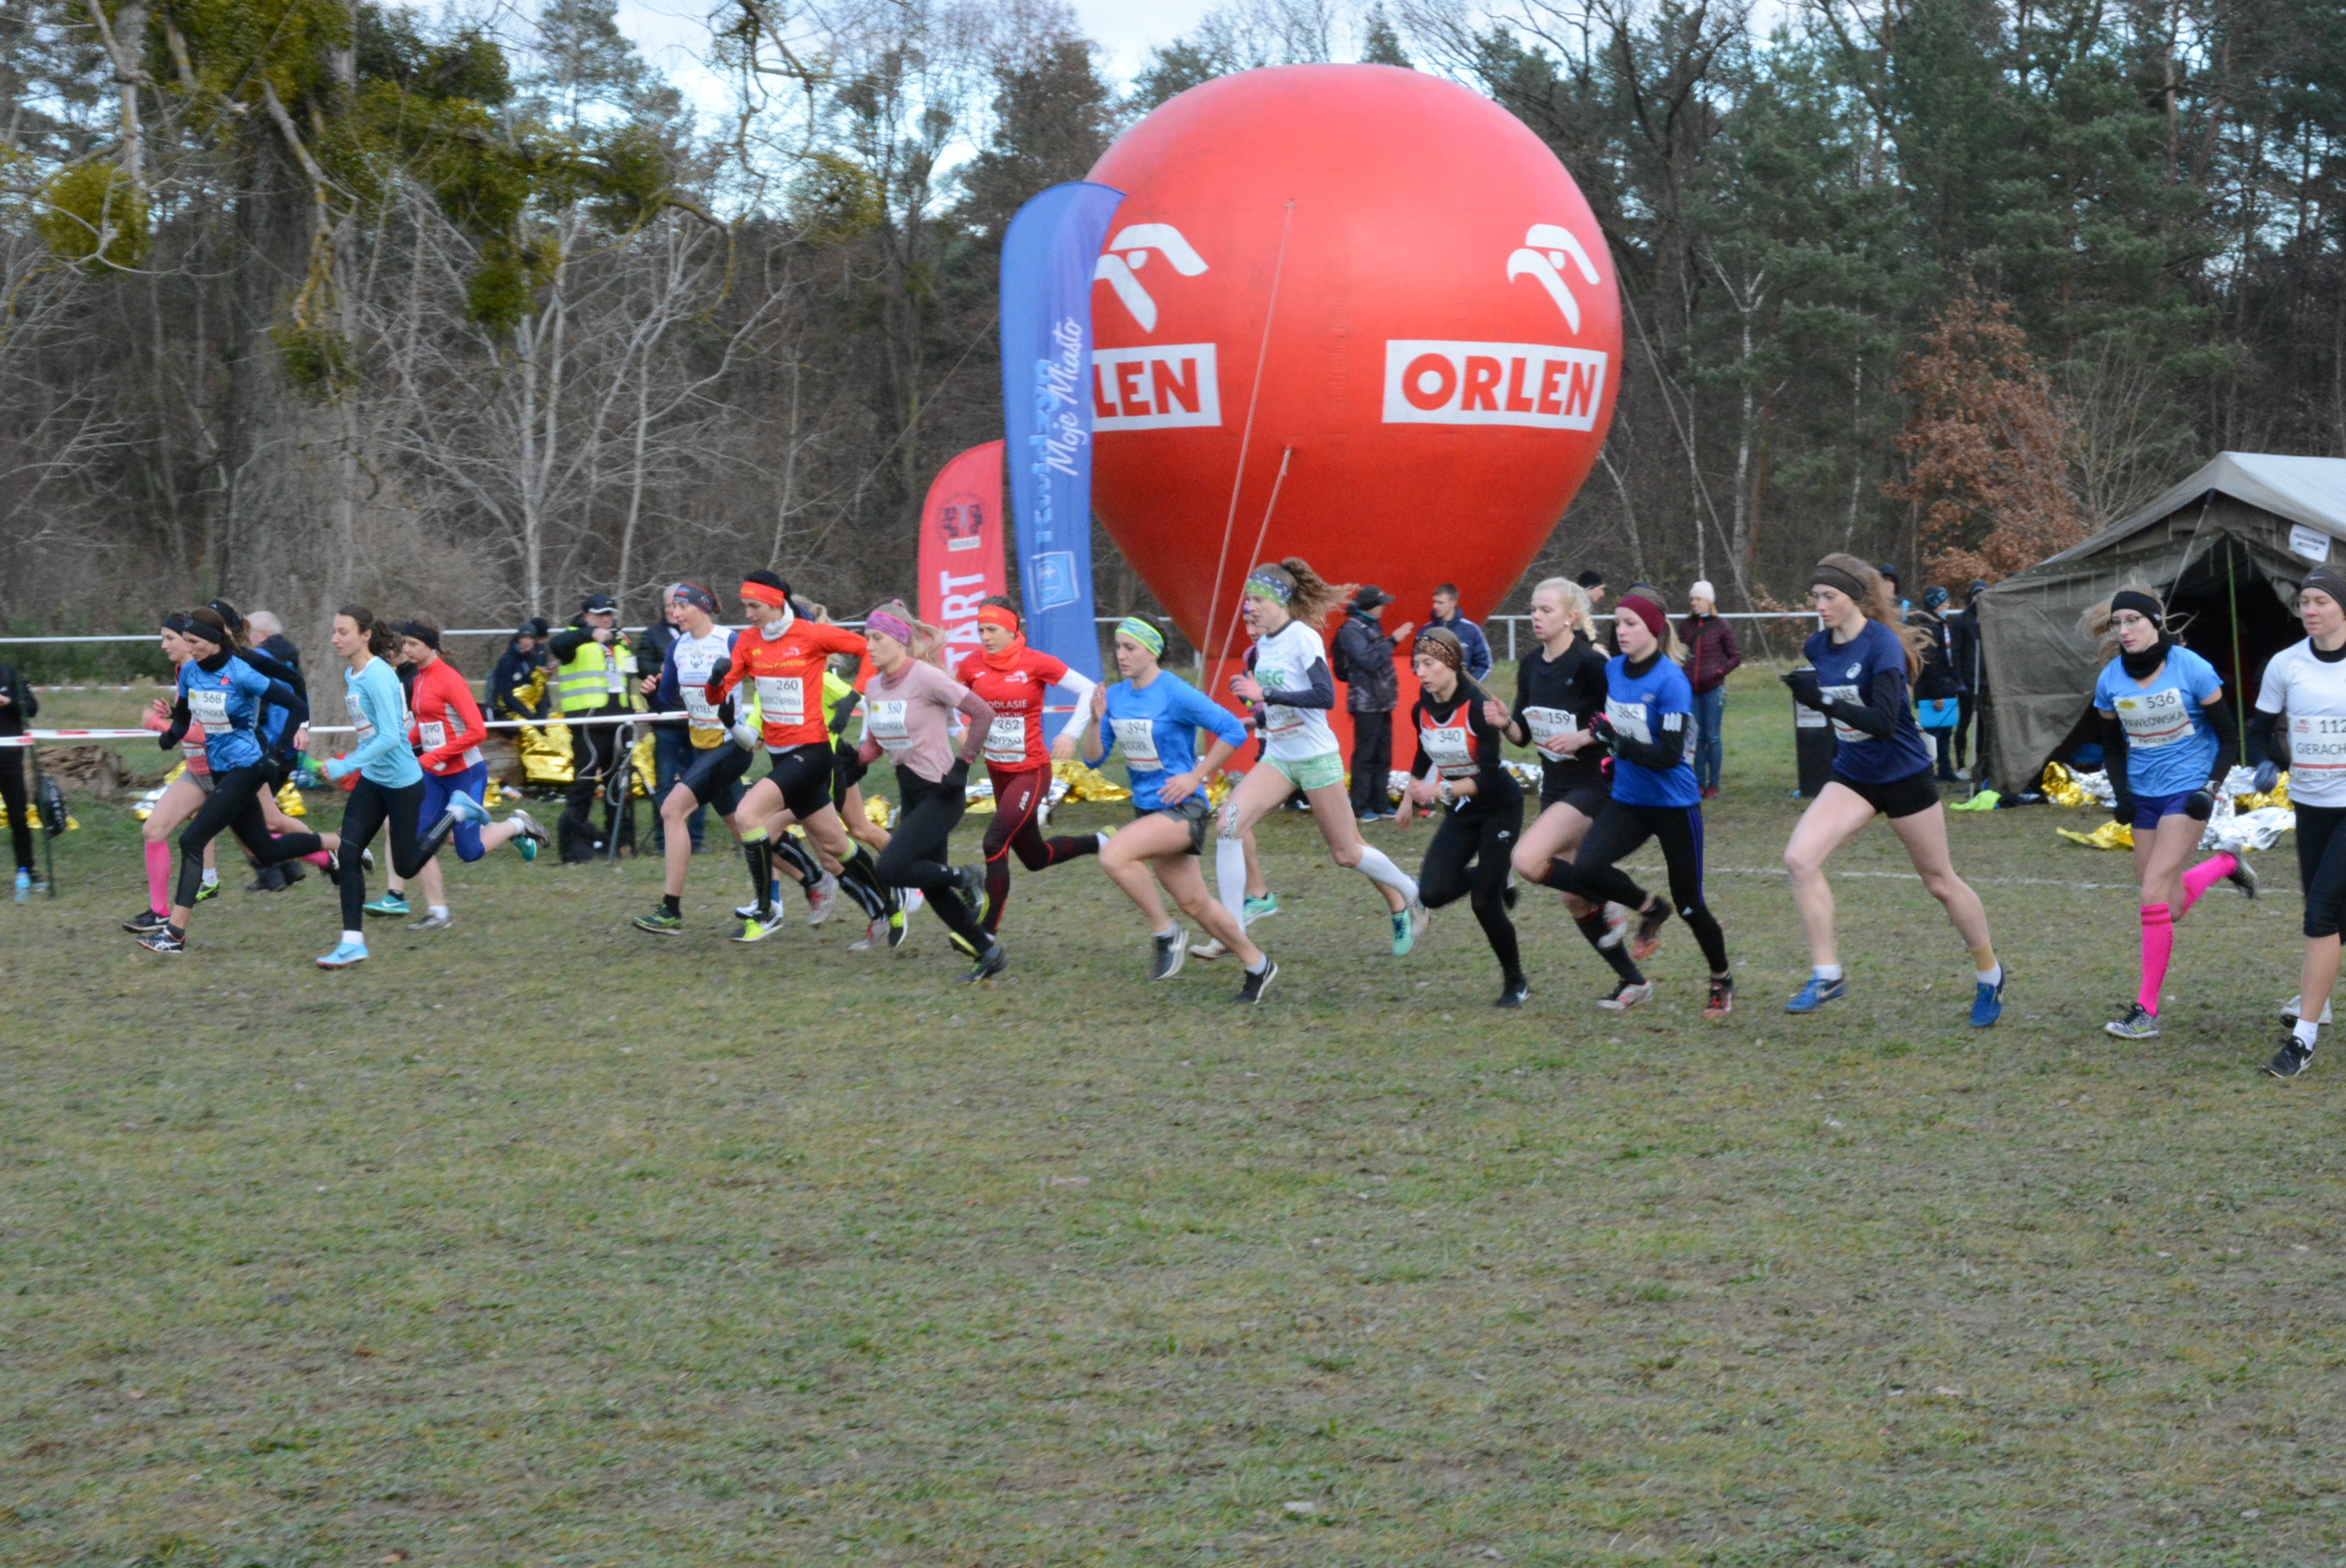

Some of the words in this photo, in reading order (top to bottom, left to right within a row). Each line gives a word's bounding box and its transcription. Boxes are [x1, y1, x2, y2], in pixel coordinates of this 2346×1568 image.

[1047, 315, 1084, 405] Miasto
[1402, 352, 1598, 417] ORLEN
[1045, 411, 1089, 477] Moje
[776, 680, 798, 691] 260
[203, 692, 222, 704] 568
[2146, 691, 2176, 709] 536
[997, 719, 1021, 730] 262
[1548, 712, 1571, 725] 159
[2122, 710, 2185, 728] PAWŁOWSKA
[423, 724, 440, 734] 390
[1438, 730, 1461, 742] 340
